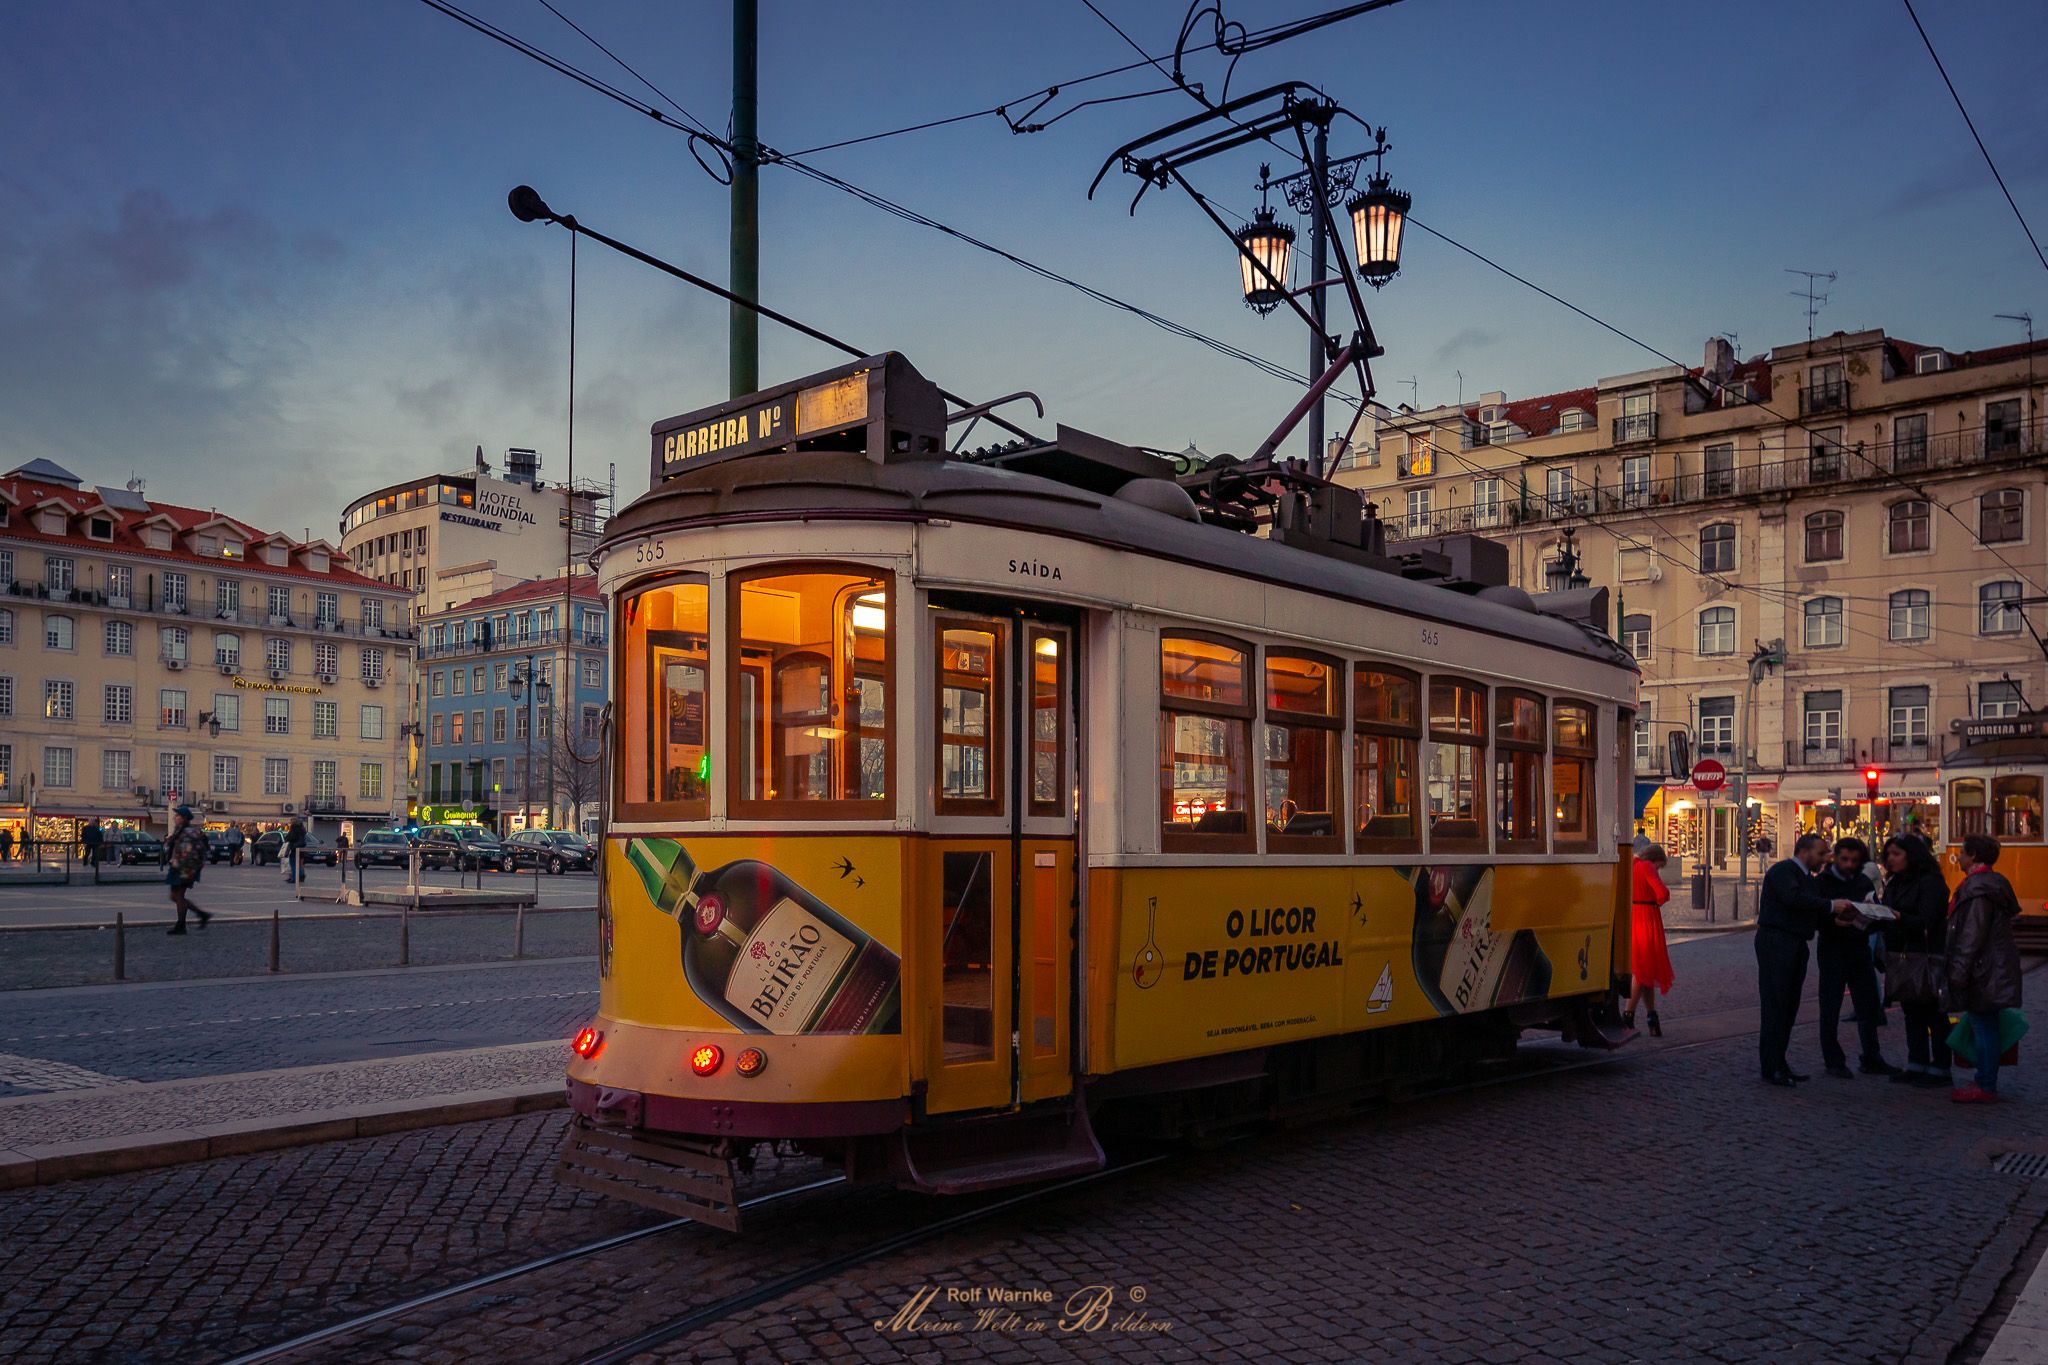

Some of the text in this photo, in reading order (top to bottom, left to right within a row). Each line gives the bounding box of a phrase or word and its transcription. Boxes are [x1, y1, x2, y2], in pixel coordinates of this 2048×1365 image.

[664, 415, 749, 464] CARREIRA
[480, 490, 522, 509] HOTEL
[440, 511, 503, 532] RESTAURANTE
[479, 503, 537, 525] MUNDIAL
[636, 540, 665, 563] 565
[1008, 558, 1062, 580] SAÍDA
[1422, 629, 1439, 645] 565
[286, 686, 322, 695] FIGUEIRA
[1967, 724, 2015, 736] CARREIRA
[1226, 907, 1317, 938] O LICOR
[750, 924, 821, 1020] BEIRÃO
[759, 941, 788, 982] LICOR
[1183, 941, 1343, 981] DE PORTUGAL
[784, 989, 798, 1013] LICOR
[796, 978, 805, 991] DE
[802, 945, 828, 981] PORTUGAL
